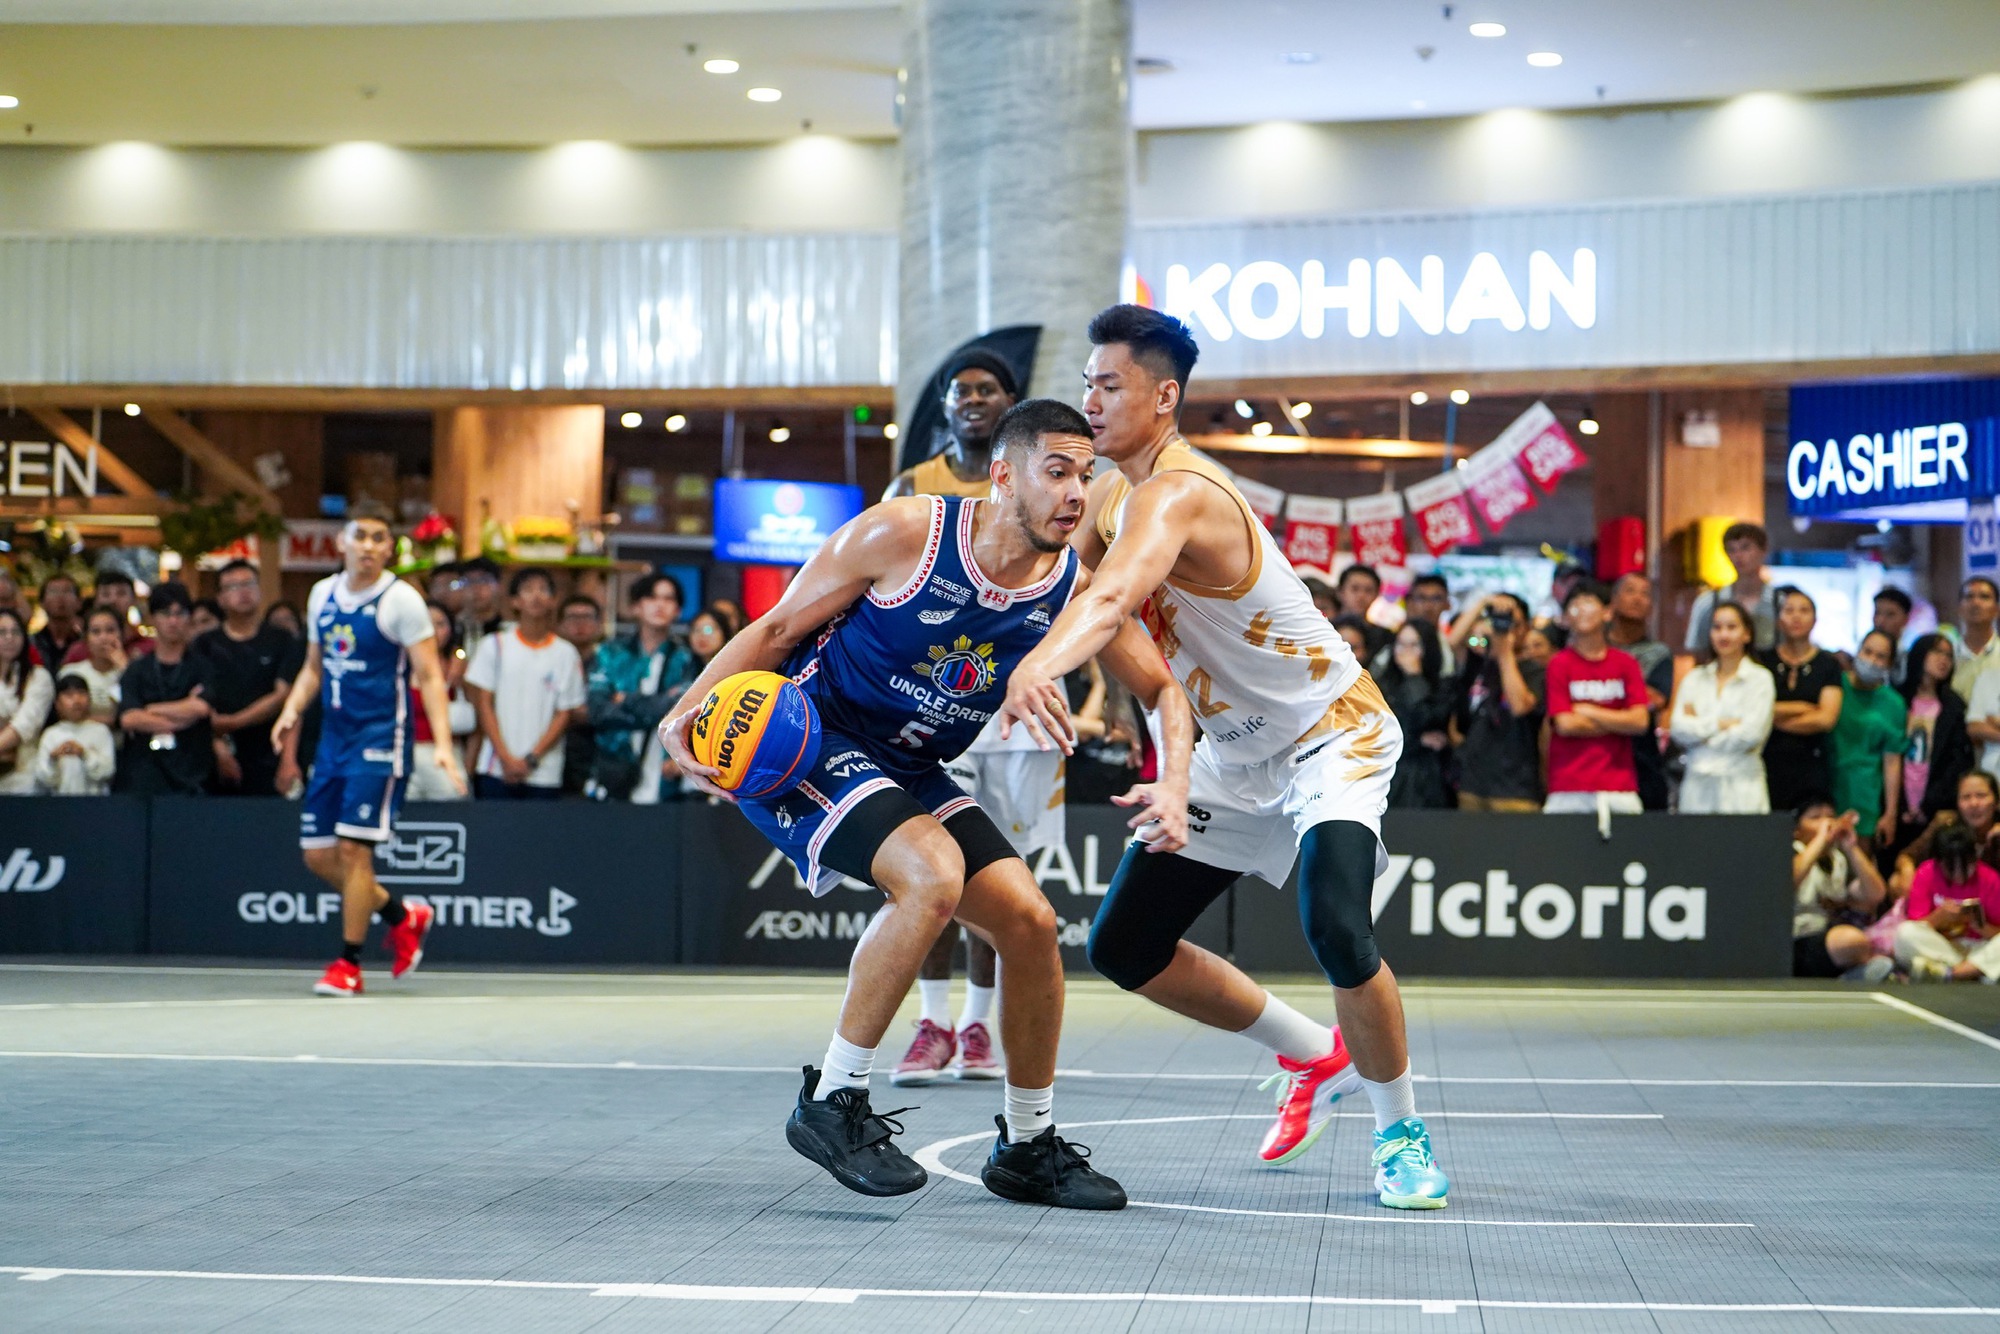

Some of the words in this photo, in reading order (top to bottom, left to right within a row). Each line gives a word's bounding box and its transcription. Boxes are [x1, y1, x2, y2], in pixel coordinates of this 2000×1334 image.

[1166, 247, 1597, 342] KOHNAN
[1787, 422, 1969, 500] CASHIER
[928, 585, 967, 606] VIETNAM
[889, 675, 947, 711] UNCLE
[718, 688, 769, 769] Wilson
[916, 703, 955, 725] MANILA
[922, 716, 941, 727] EXE
[946, 703, 992, 723] DREW
[888, 720, 937, 749] 5
[238, 891, 342, 924] GOLF
